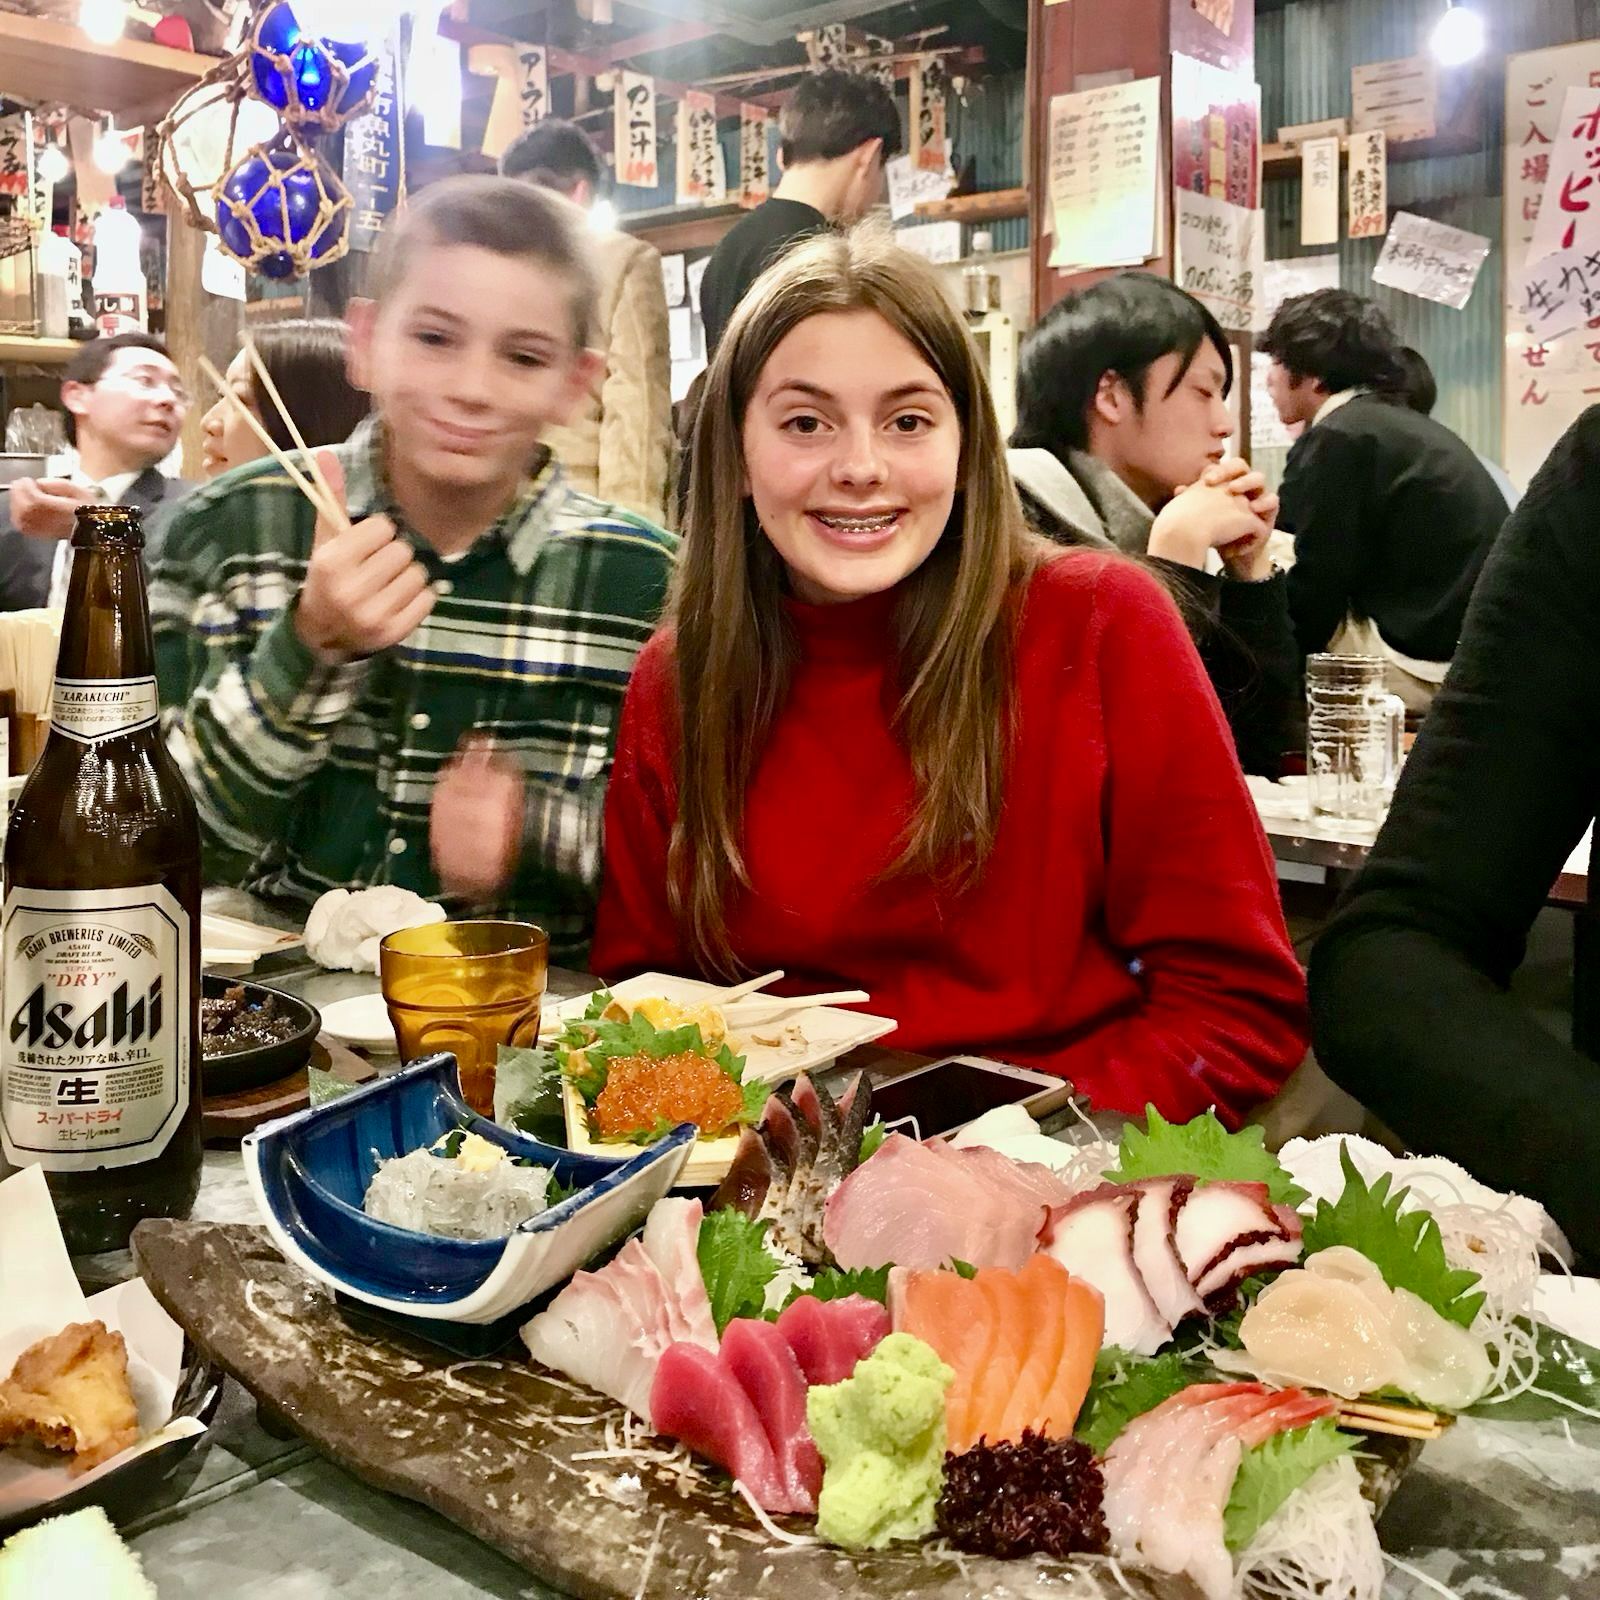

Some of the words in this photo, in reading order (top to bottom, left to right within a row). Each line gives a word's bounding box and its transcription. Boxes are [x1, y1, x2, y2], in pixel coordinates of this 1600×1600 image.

[60, 691, 131, 702] "KARAKUCHI"
[24, 936, 47, 960] ASAHI
[49, 928, 104, 944] BREWERIES
[108, 933, 142, 959] LIMITED
[10, 974, 162, 1049] Asahi
[57, 1077, 99, 1106] 生
[37, 1108, 123, 1124] スーパードライ
[58, 1128, 98, 1141] 生ビール
